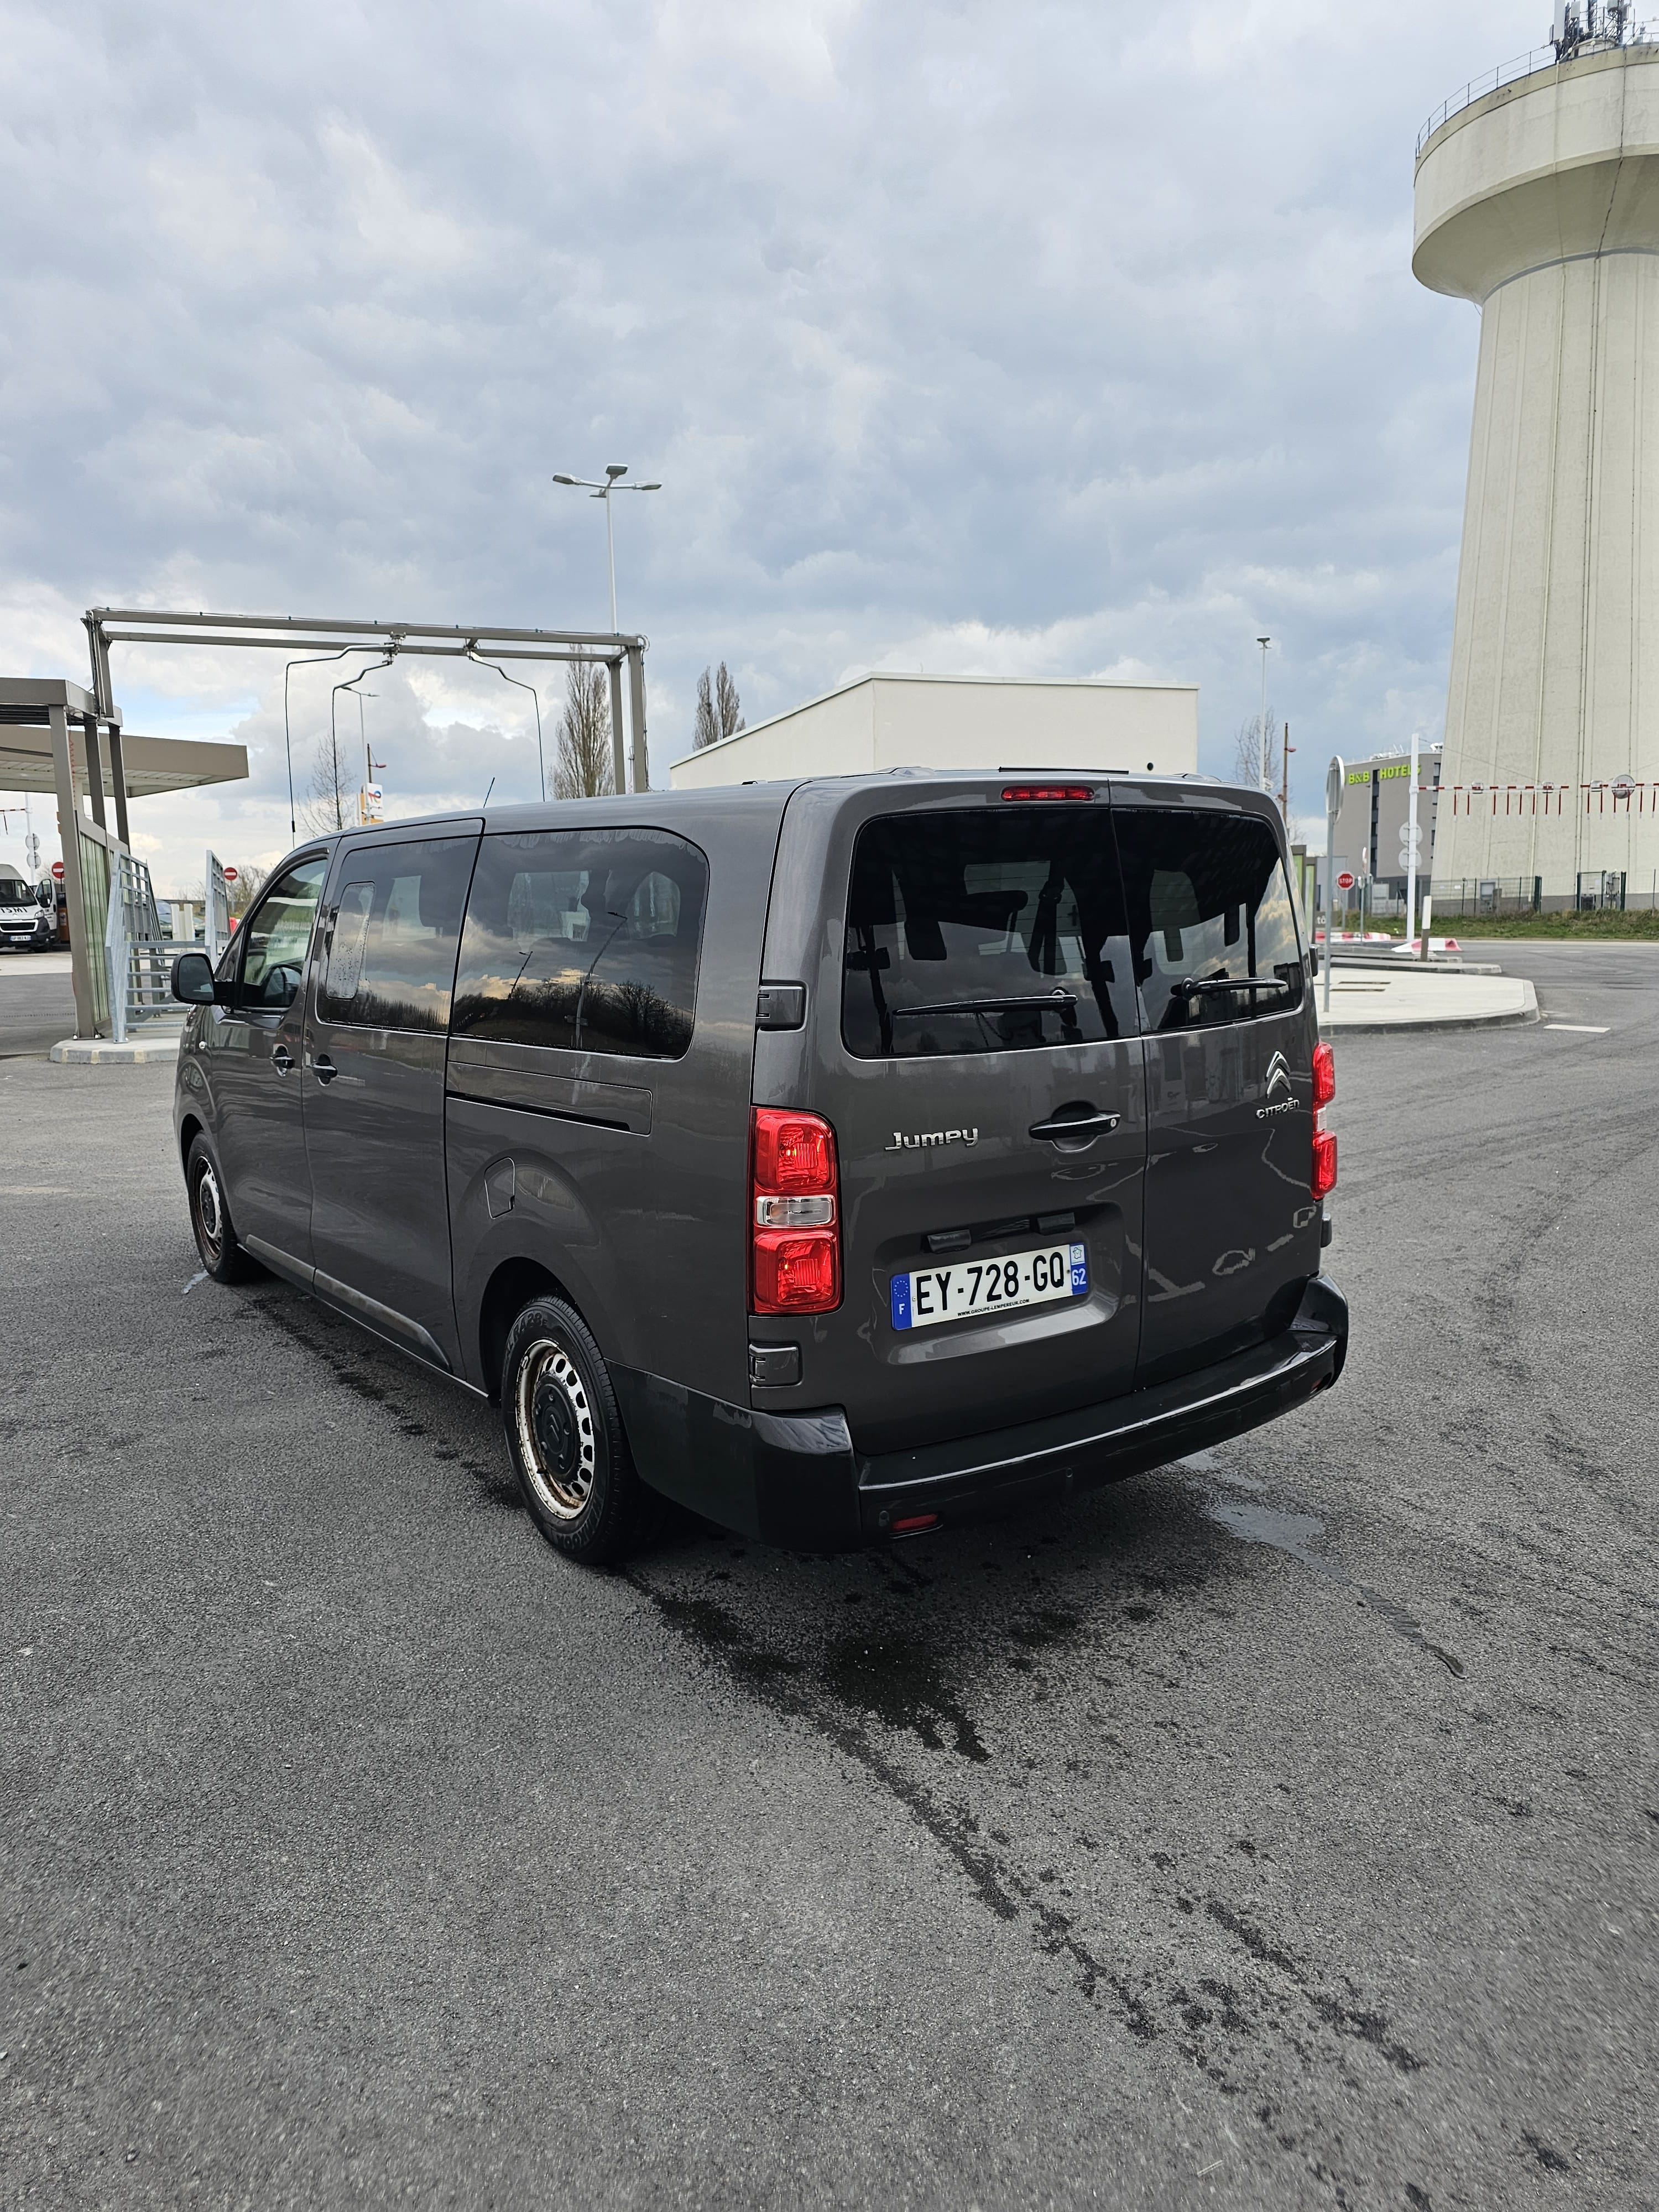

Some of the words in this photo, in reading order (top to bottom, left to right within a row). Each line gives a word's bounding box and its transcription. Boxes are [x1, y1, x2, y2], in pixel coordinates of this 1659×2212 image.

[1349, 771, 1369, 784] B&B
[1256, 1097, 1300, 1119] CITROËN
[885, 1128, 978, 1150] Jumpy
[916, 1251, 1065, 1316] EY-728-GQ
[1072, 1268, 1087, 1286] 62
[899, 1303, 905, 1315] F
